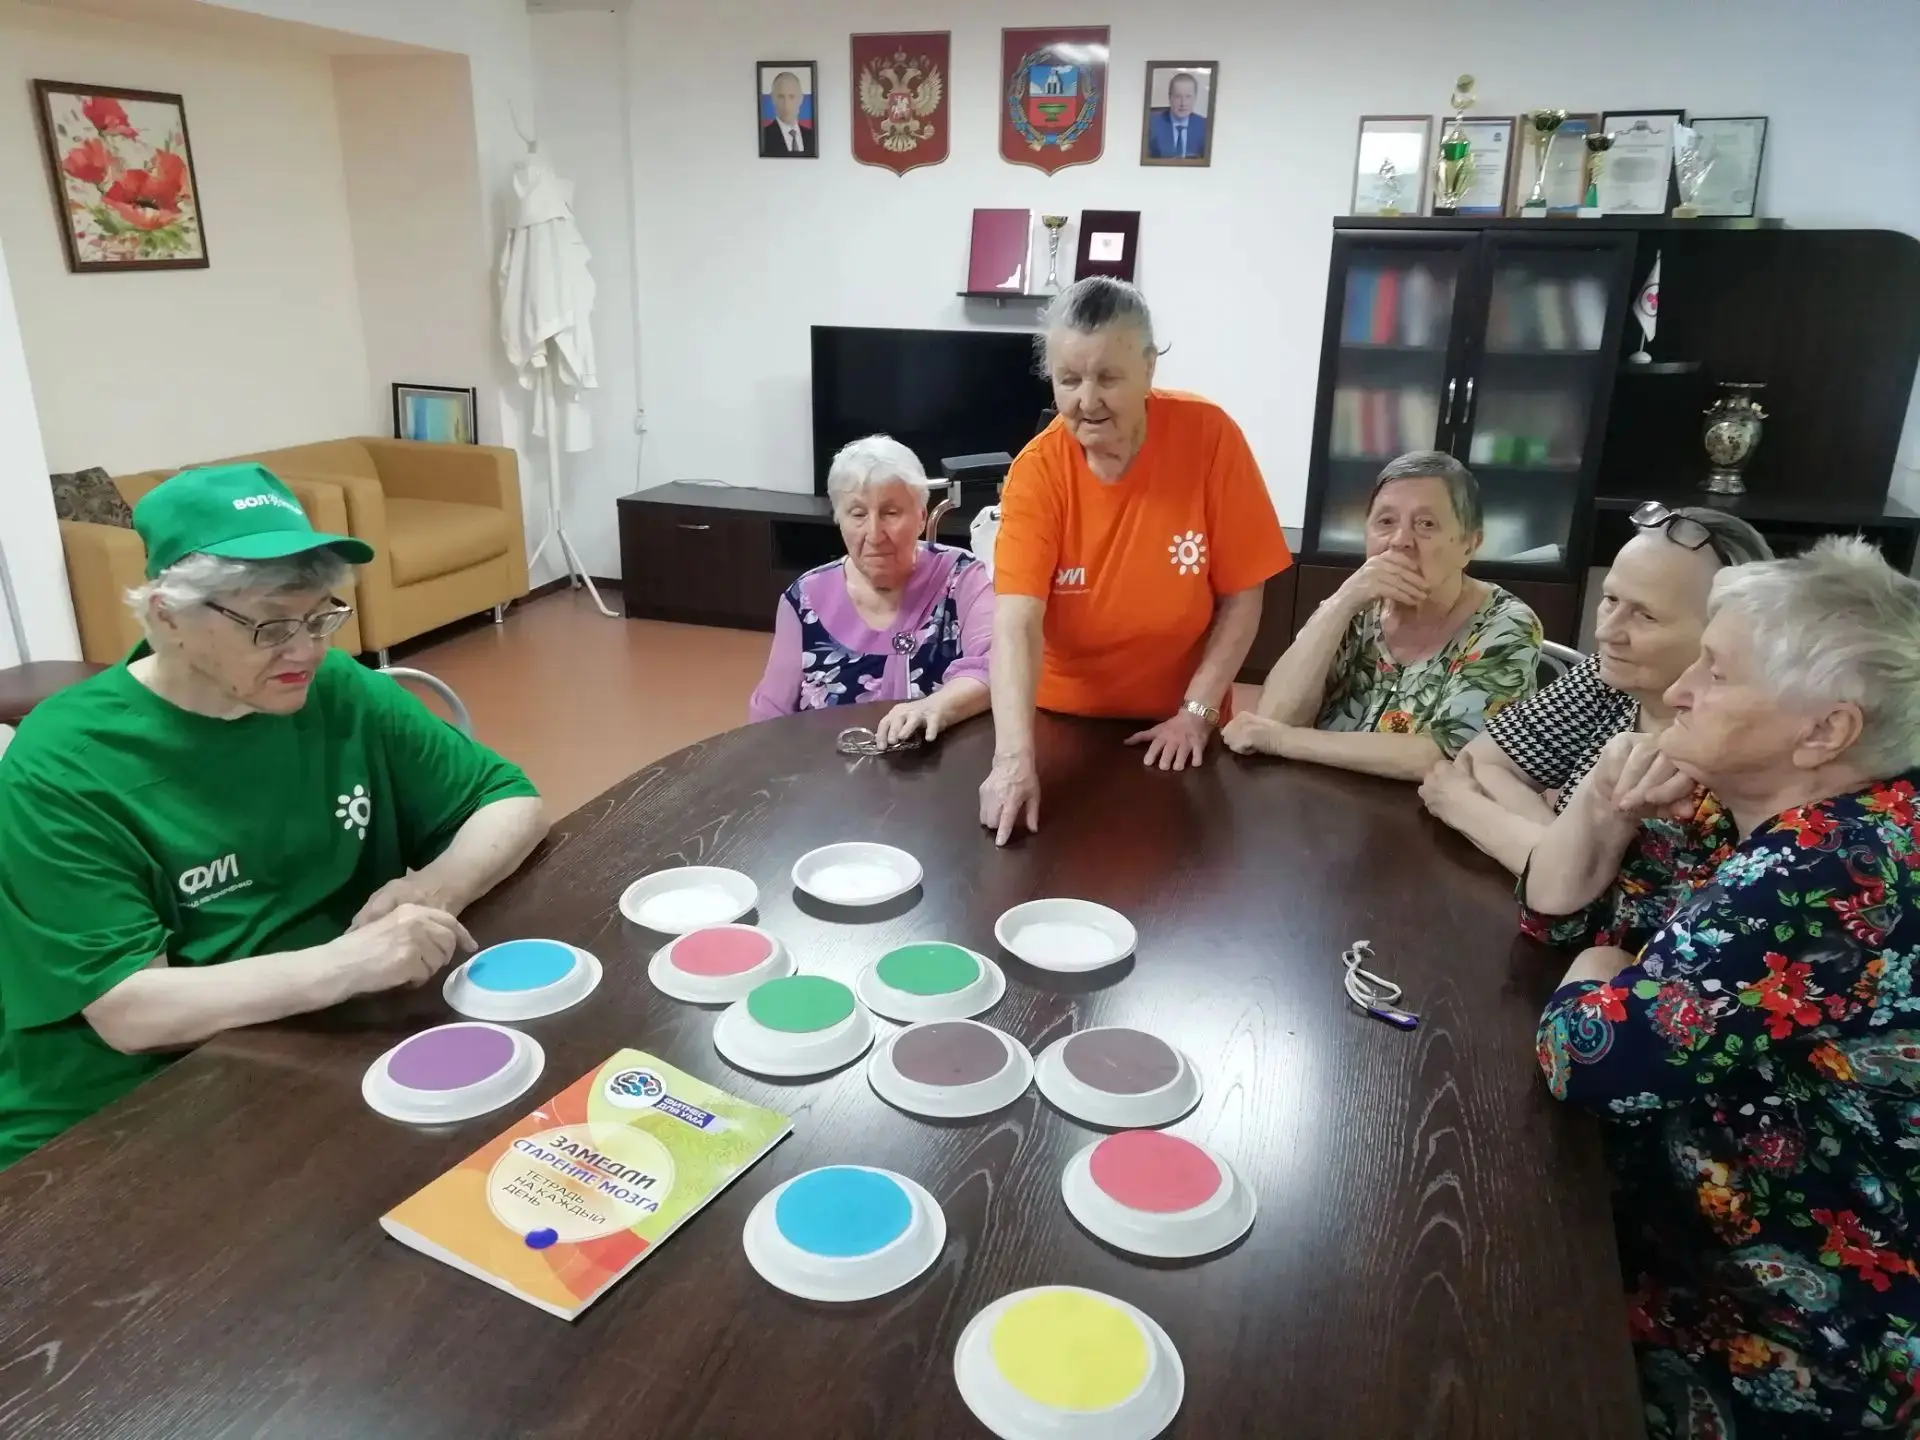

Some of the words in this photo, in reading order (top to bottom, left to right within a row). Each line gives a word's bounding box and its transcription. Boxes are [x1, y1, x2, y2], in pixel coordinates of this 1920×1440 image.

[655, 1102, 681, 1115] ДЛЯ
[680, 1111, 704, 1127] УМА
[663, 1097, 708, 1119] ФИТНЕС
[548, 1135, 657, 1190] ЗАМЕДЛИ
[512, 1139, 599, 1186] СТАРЕНИЕ
[598, 1180, 660, 1214] МОЗГА
[513, 1176, 535, 1192] НА
[526, 1169, 585, 1205] ТЕТРАДЬ
[502, 1183, 542, 1208] ДЕНЬ
